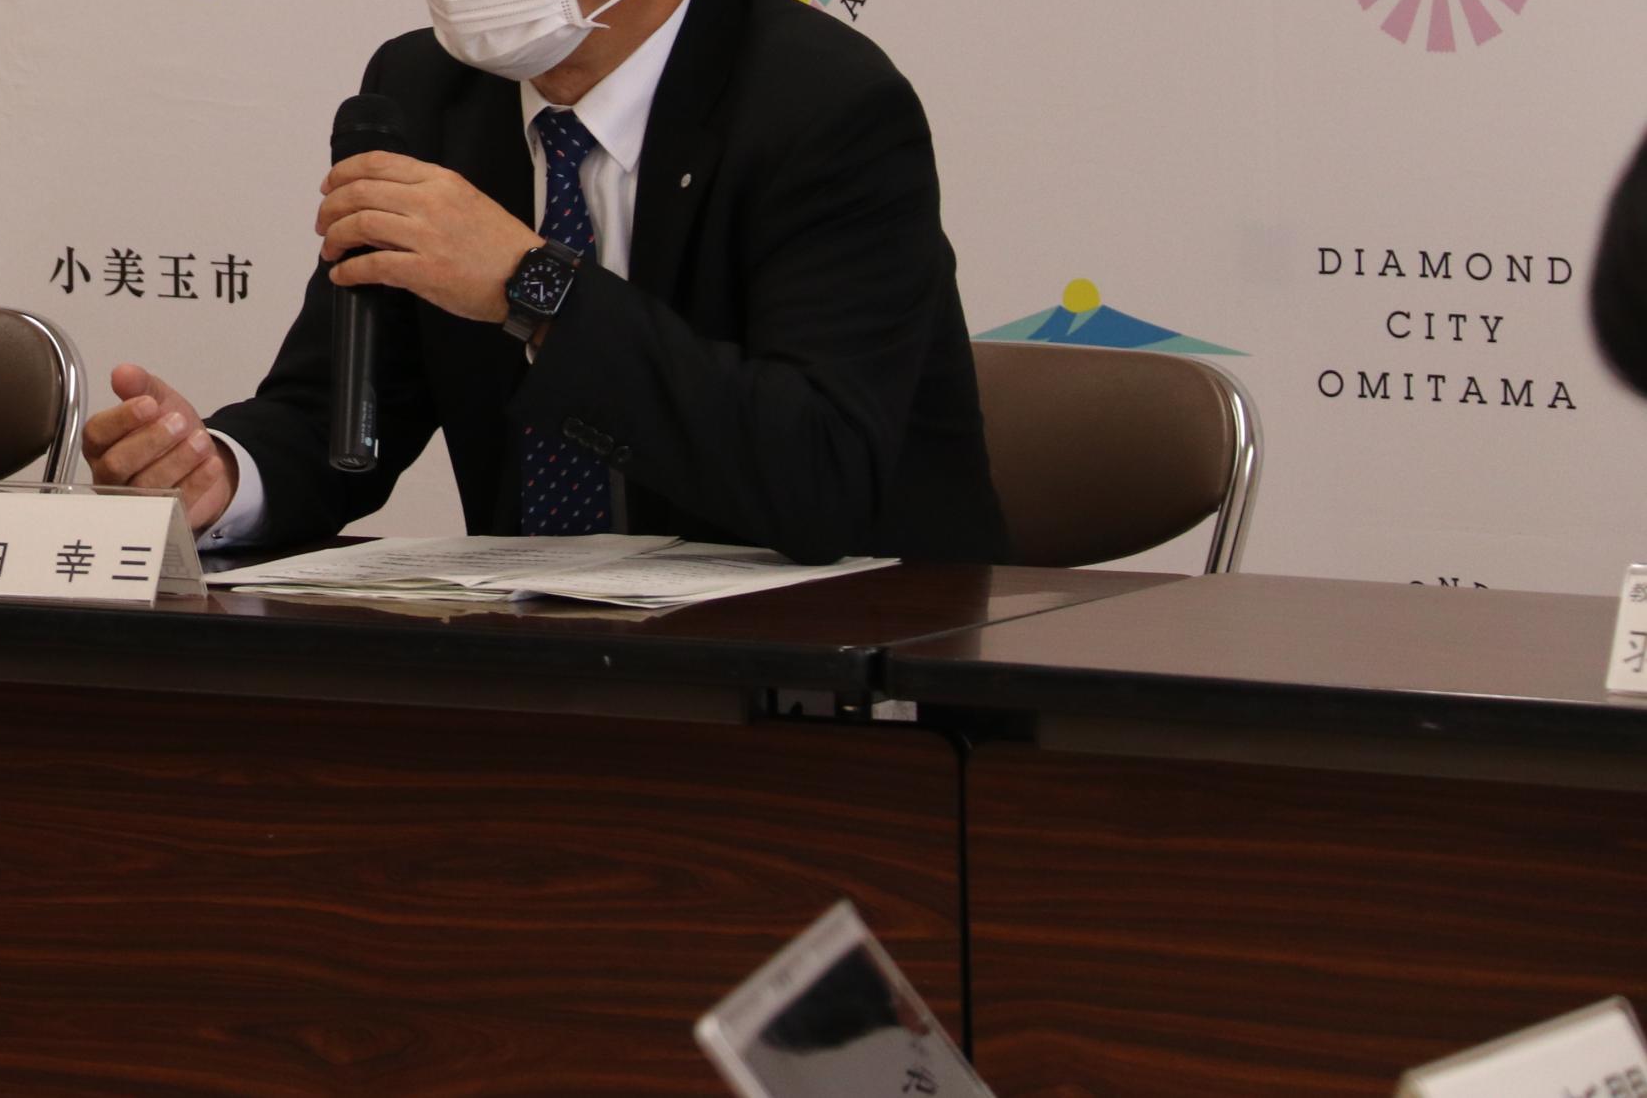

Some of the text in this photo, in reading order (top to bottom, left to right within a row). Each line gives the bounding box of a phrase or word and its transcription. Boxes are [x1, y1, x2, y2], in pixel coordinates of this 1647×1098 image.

[50, 247, 252, 303] 小美玉市
[1318, 248, 1572, 284] DIAMOND
[1387, 311, 1503, 343] CITY
[1318, 370, 1576, 409] OMITAMA
[56, 540, 151, 582] 幸三
